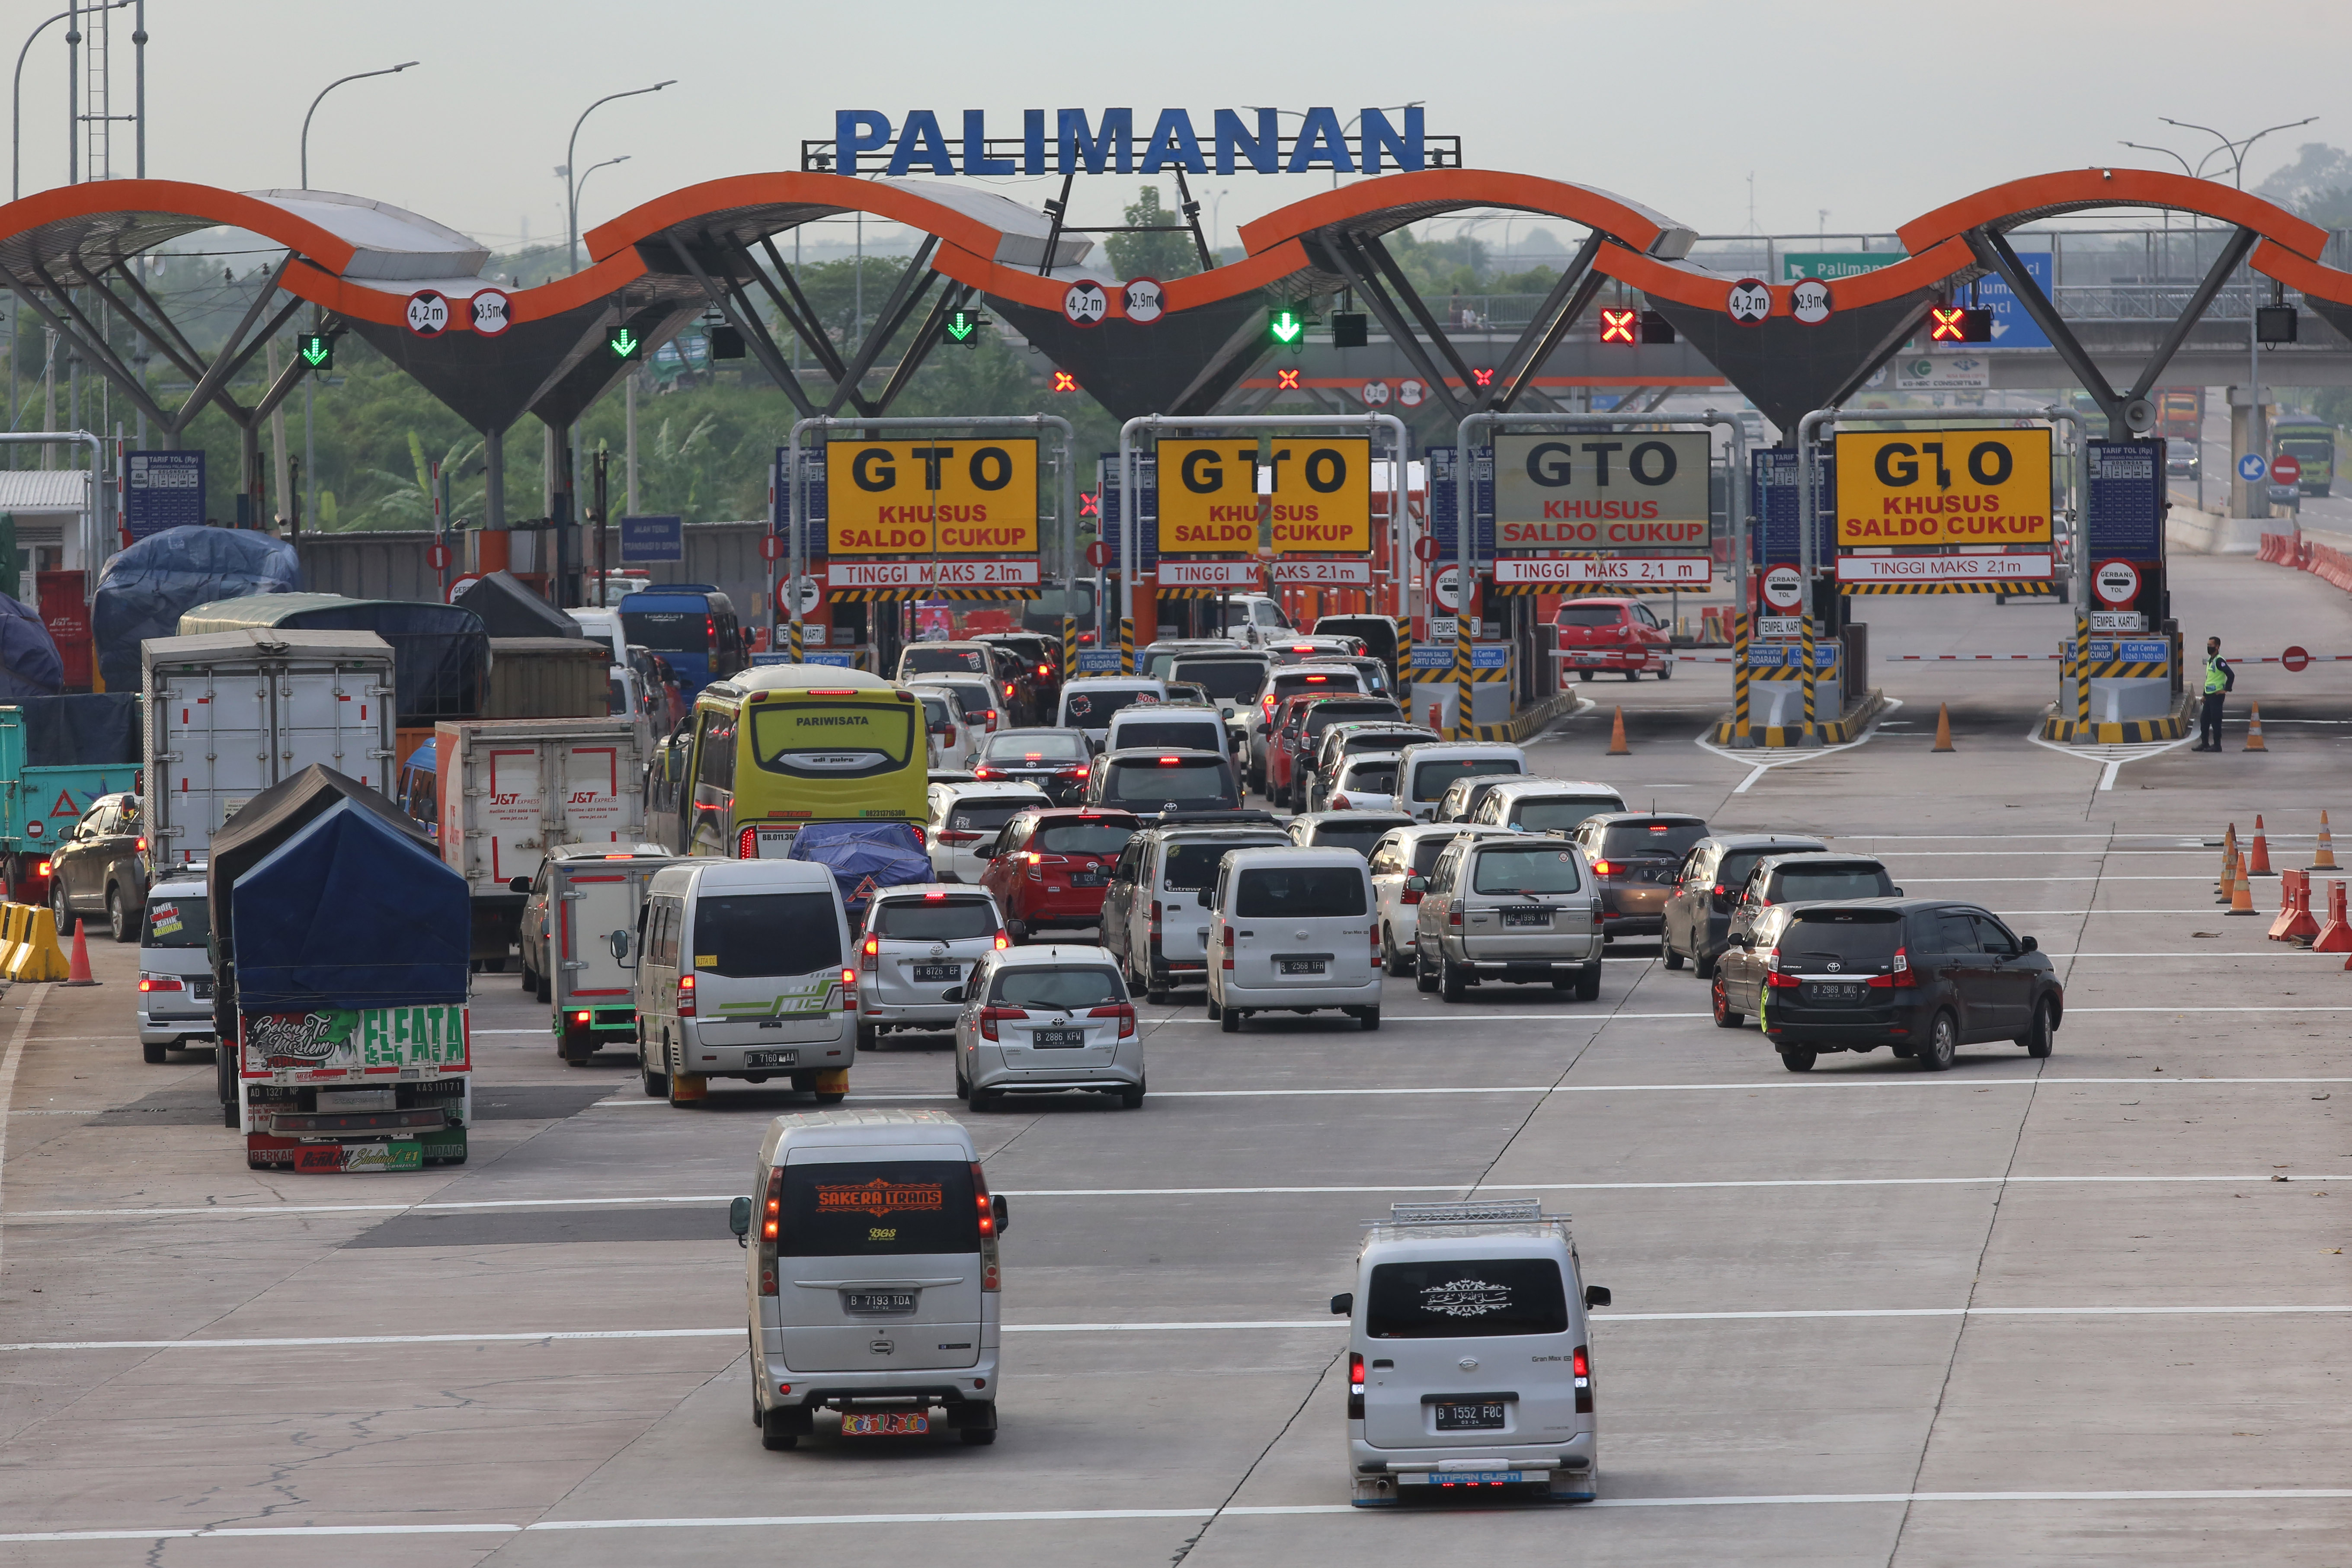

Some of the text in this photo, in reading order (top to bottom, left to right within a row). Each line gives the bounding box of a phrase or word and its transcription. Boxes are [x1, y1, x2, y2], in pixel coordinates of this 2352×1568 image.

[835, 107, 1424, 176] PALIMANAN
[2139, 447, 2153, 455] (Rp)
[852, 447, 1012, 492] GTO
[1181, 448, 1346, 494] GTO
[1526, 441, 1677, 487] GTO
[1544, 500, 1658, 518] KHUSUS
[1883, 494, 1998, 514] KHUSUS
[879, 505, 986, 523] KHUSUS
[1210, 505, 1318, 521] KHUSUS
[1175, 525, 1353, 541] SALDO CUKUP
[1504, 523, 1703, 541] SALDO CUKUP
[1845, 515, 2044, 537] SALDO CUKUP
[839, 528, 1025, 547] SALDO CUKUP
[846, 566, 907, 583] TINGGI
[920, 565, 975, 582] MAKS
[1175, 567, 1229, 581] TINGGI
[1247, 565, 1309, 580] MAKS
[1514, 564, 1569, 578] TINGGI
[1586, 563, 1628, 577] MAKS
[1871, 562, 1924, 575] TINGGI
[1931, 560, 1977, 573] MAKS
[1434, 623, 1456, 632] TEMPEL
[1762, 622, 1784, 632] TEMPEL
[2093, 616, 2138, 627] TEMPEL KARTU
[804, 630, 822, 639] KARTU
[797, 716, 869, 726] PARIWISATA
[490, 793, 522, 805] J&T
[567, 791, 599, 803] J&T
[153, 902, 172, 913] Indit
[154, 922, 182, 936] BAROKAH
[156, 917, 177, 928] Balik
[254, 1014, 331, 1041] Belong To
[1046, 1033, 1062, 1041] 2886
[1067, 1032, 1081, 1040] KFW
[269, 1034, 334, 1059] Moslem
[267, 1058, 316, 1067] FOREVER
[748, 1055, 752, 1063] D
[760, 1053, 777, 1062] 7160
[251, 1087, 298, 1097] AD 1327 NP
[253, 1150, 294, 1161] BERKAH
[349, 1148, 418, 1169] Sholawat #1
[819, 1191, 940, 1205] SAKERA TRANS
[870, 1228, 896, 1238] BGS
[851, 1296, 910, 1305] B 7193 TDA
[1438, 1408, 1444, 1419] B
[1453, 1407, 1476, 1419] 1552
[844, 1413, 927, 1433] Kebal Paido
[1431, 1472, 1519, 1482] TITIPAN GUSTI
